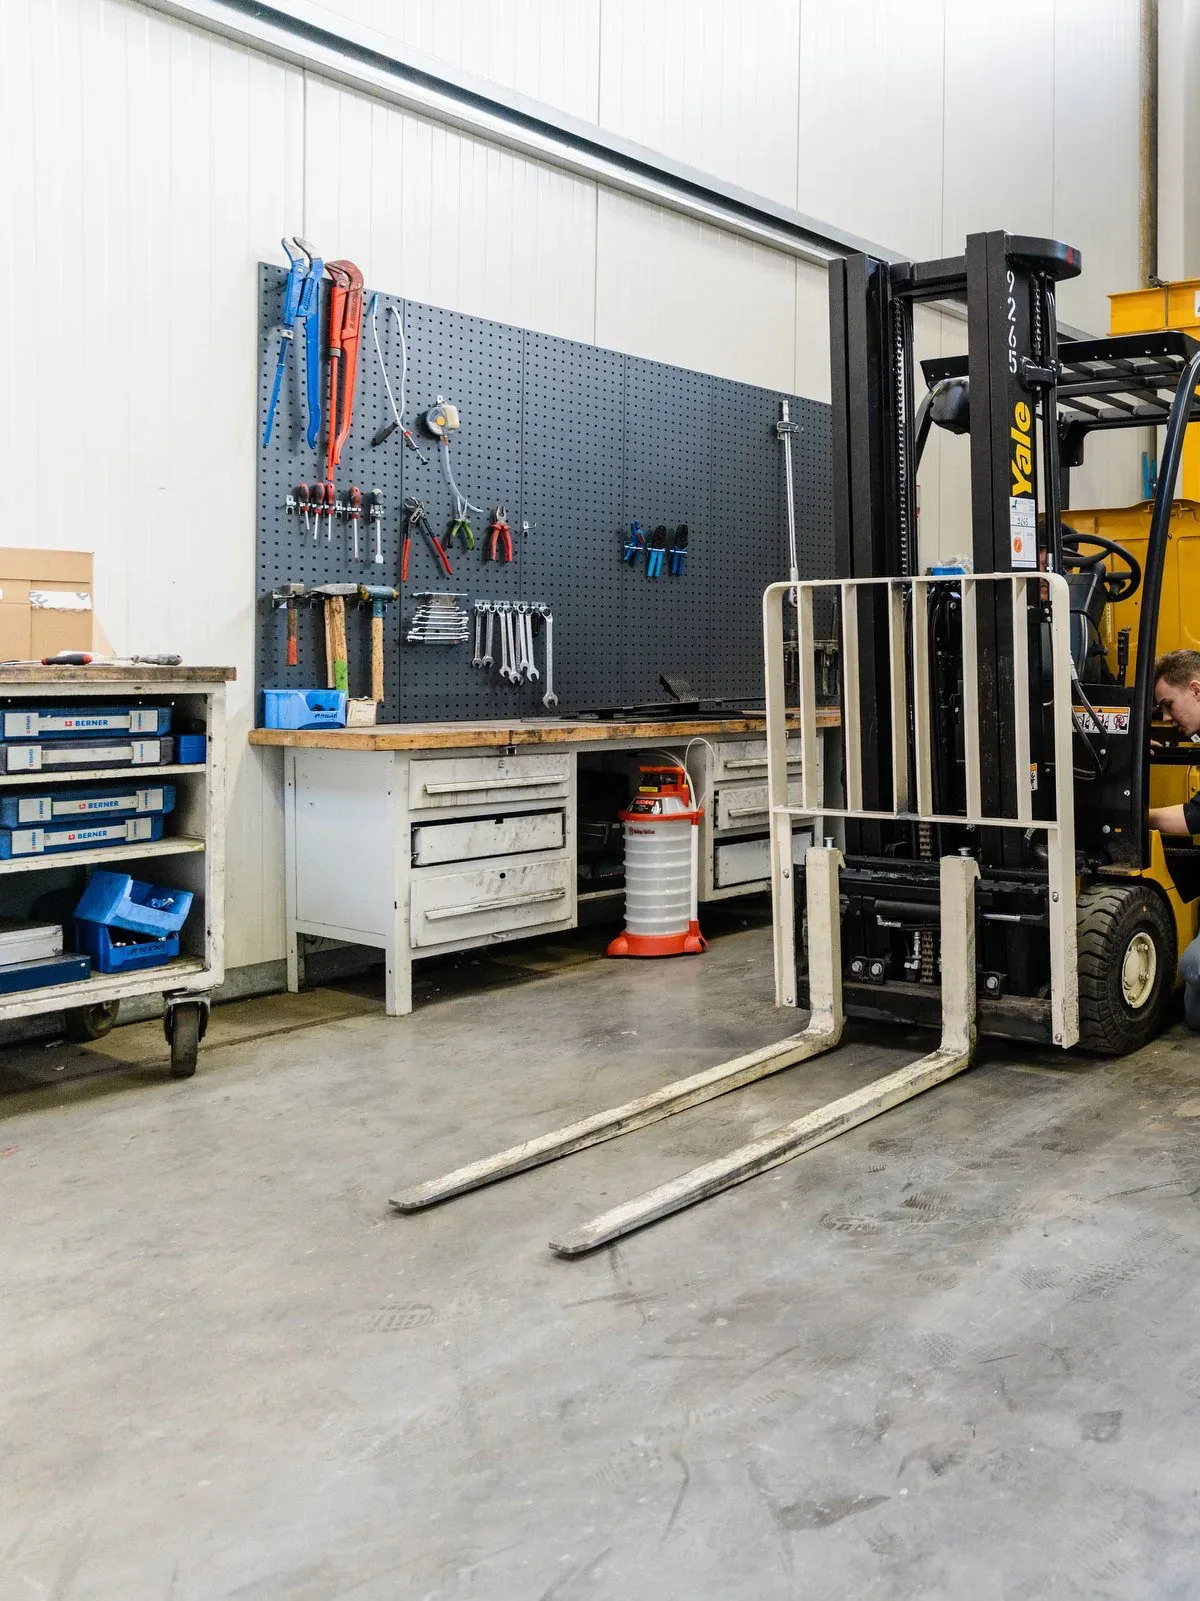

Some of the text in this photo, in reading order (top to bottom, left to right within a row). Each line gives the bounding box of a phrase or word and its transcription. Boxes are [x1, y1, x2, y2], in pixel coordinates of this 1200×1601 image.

[1006, 269, 1018, 375] 9265
[1010, 400, 1033, 497] Yale
[75, 718, 109, 727] BERNER
[88, 800, 120, 809] BERNER
[77, 829, 108, 840] BERNER
